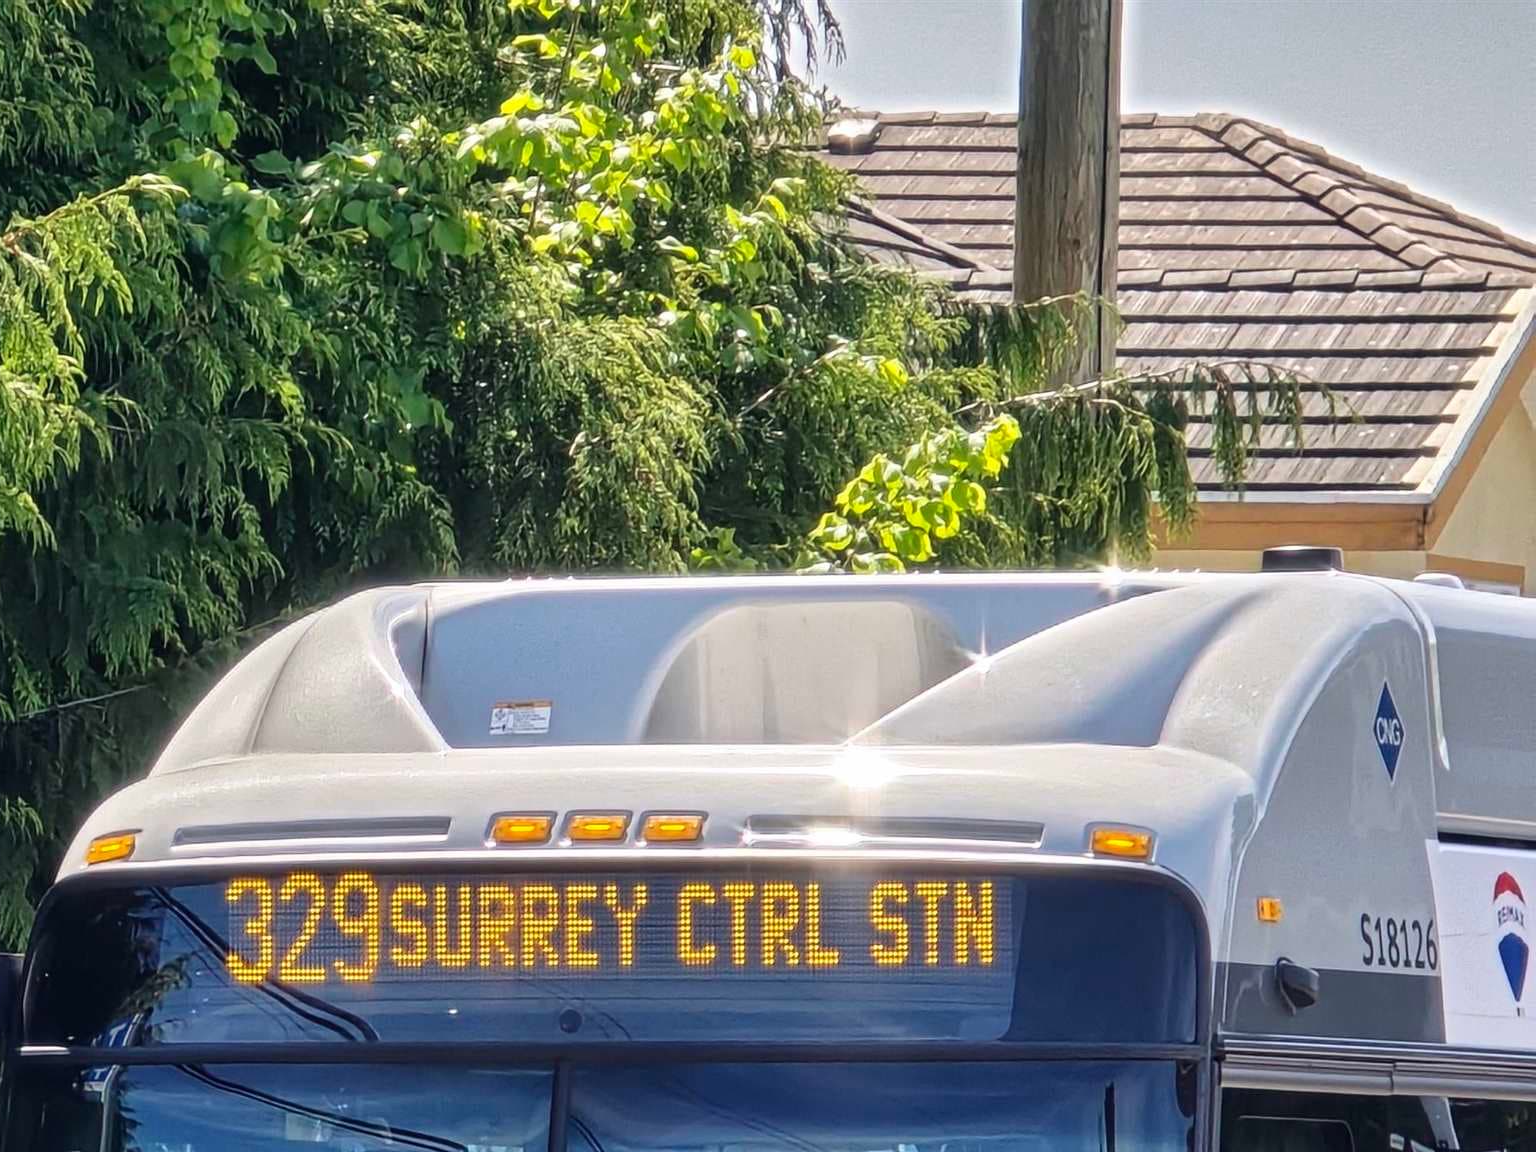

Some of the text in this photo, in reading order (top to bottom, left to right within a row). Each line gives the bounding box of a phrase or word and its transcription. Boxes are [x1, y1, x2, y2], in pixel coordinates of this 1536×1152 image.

[1377, 717, 1401, 746] CNG
[225, 872, 994, 984] 329 SURREY CTRL STN
[1360, 913, 1438, 970] S18126
